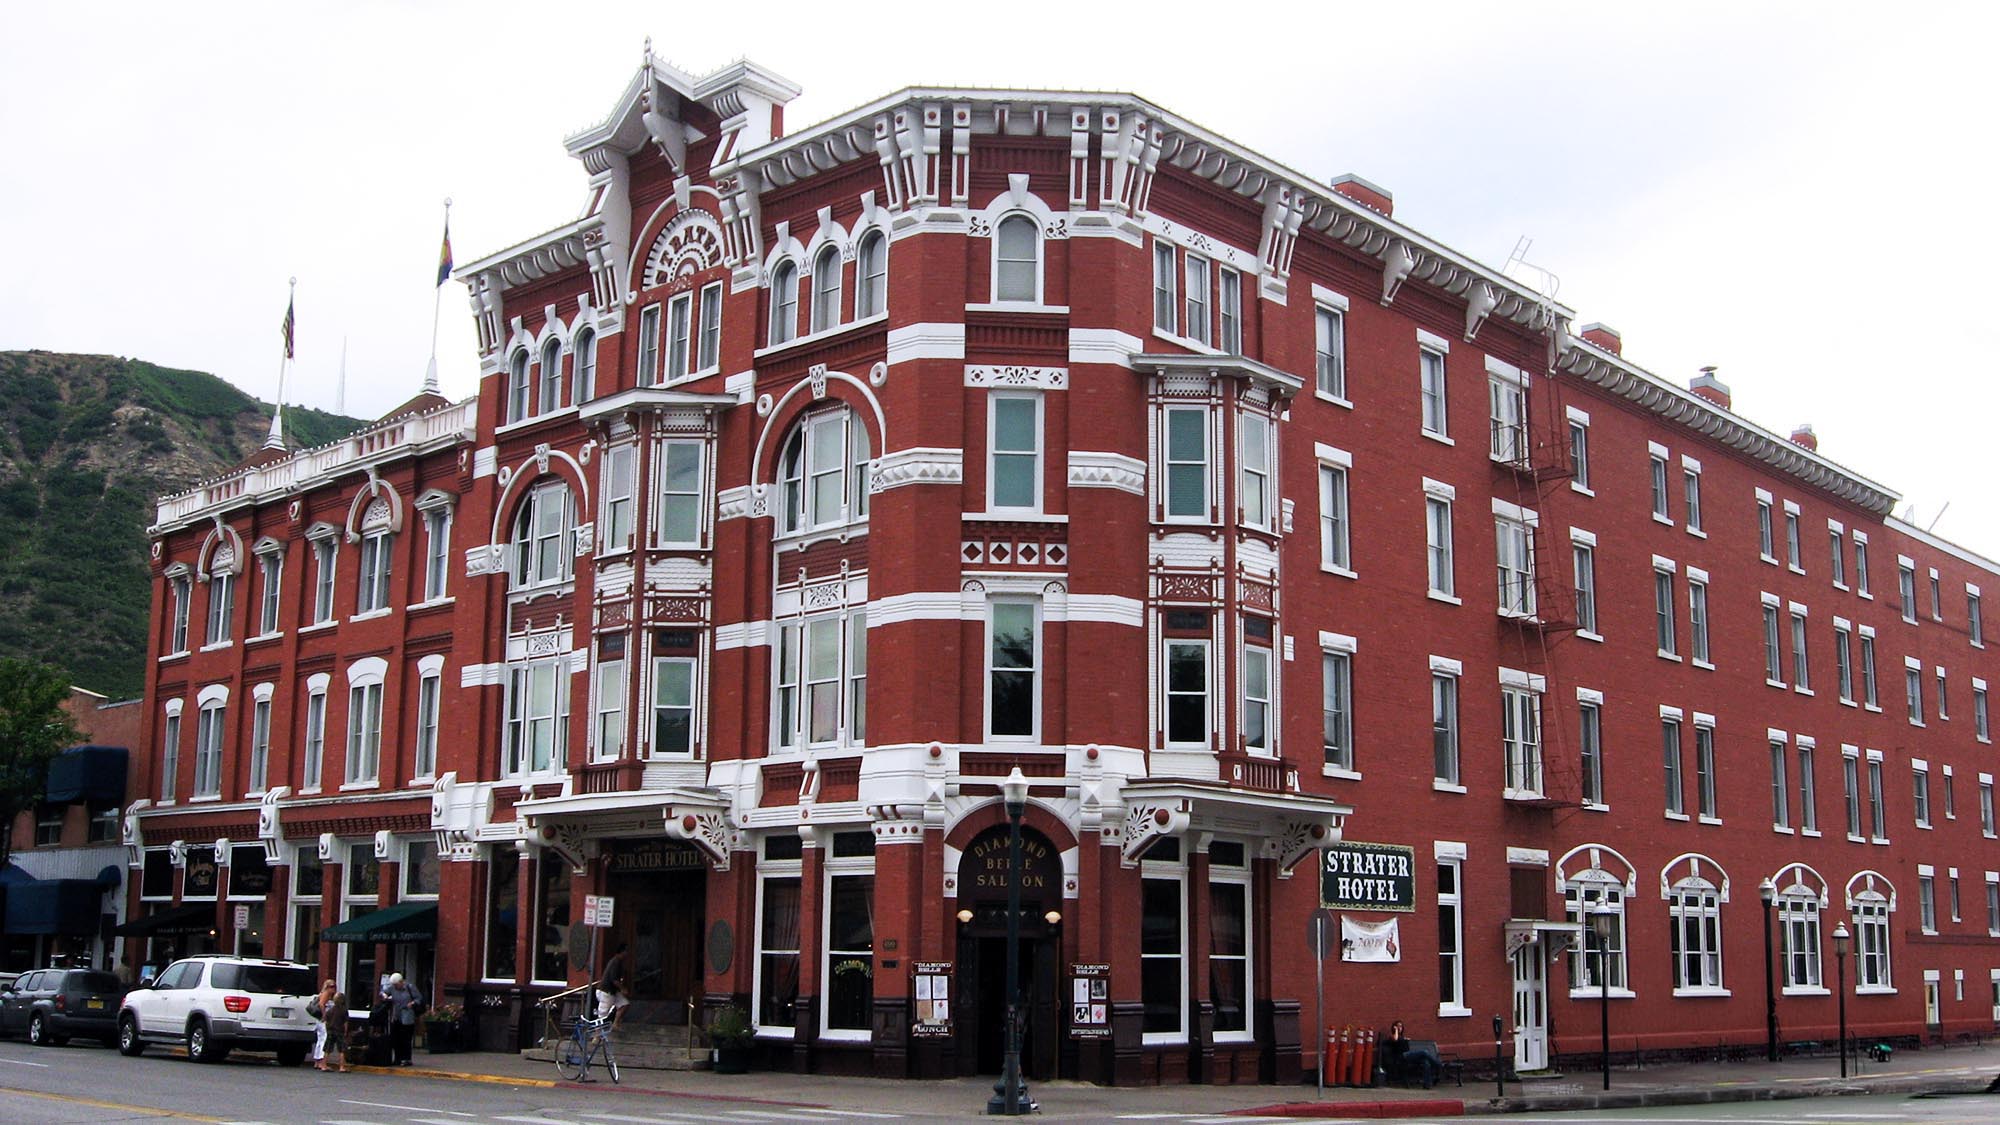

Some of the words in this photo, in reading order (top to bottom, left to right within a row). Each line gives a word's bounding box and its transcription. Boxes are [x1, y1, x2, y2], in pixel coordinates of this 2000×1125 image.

[655, 226, 721, 284] STRATER
[617, 852, 661, 869] STRATER
[665, 850, 701, 867] HOTEL
[1327, 850, 1409, 877] STRATER
[977, 874, 1043, 888] SALON
[1338, 877, 1398, 901] HOTEL
